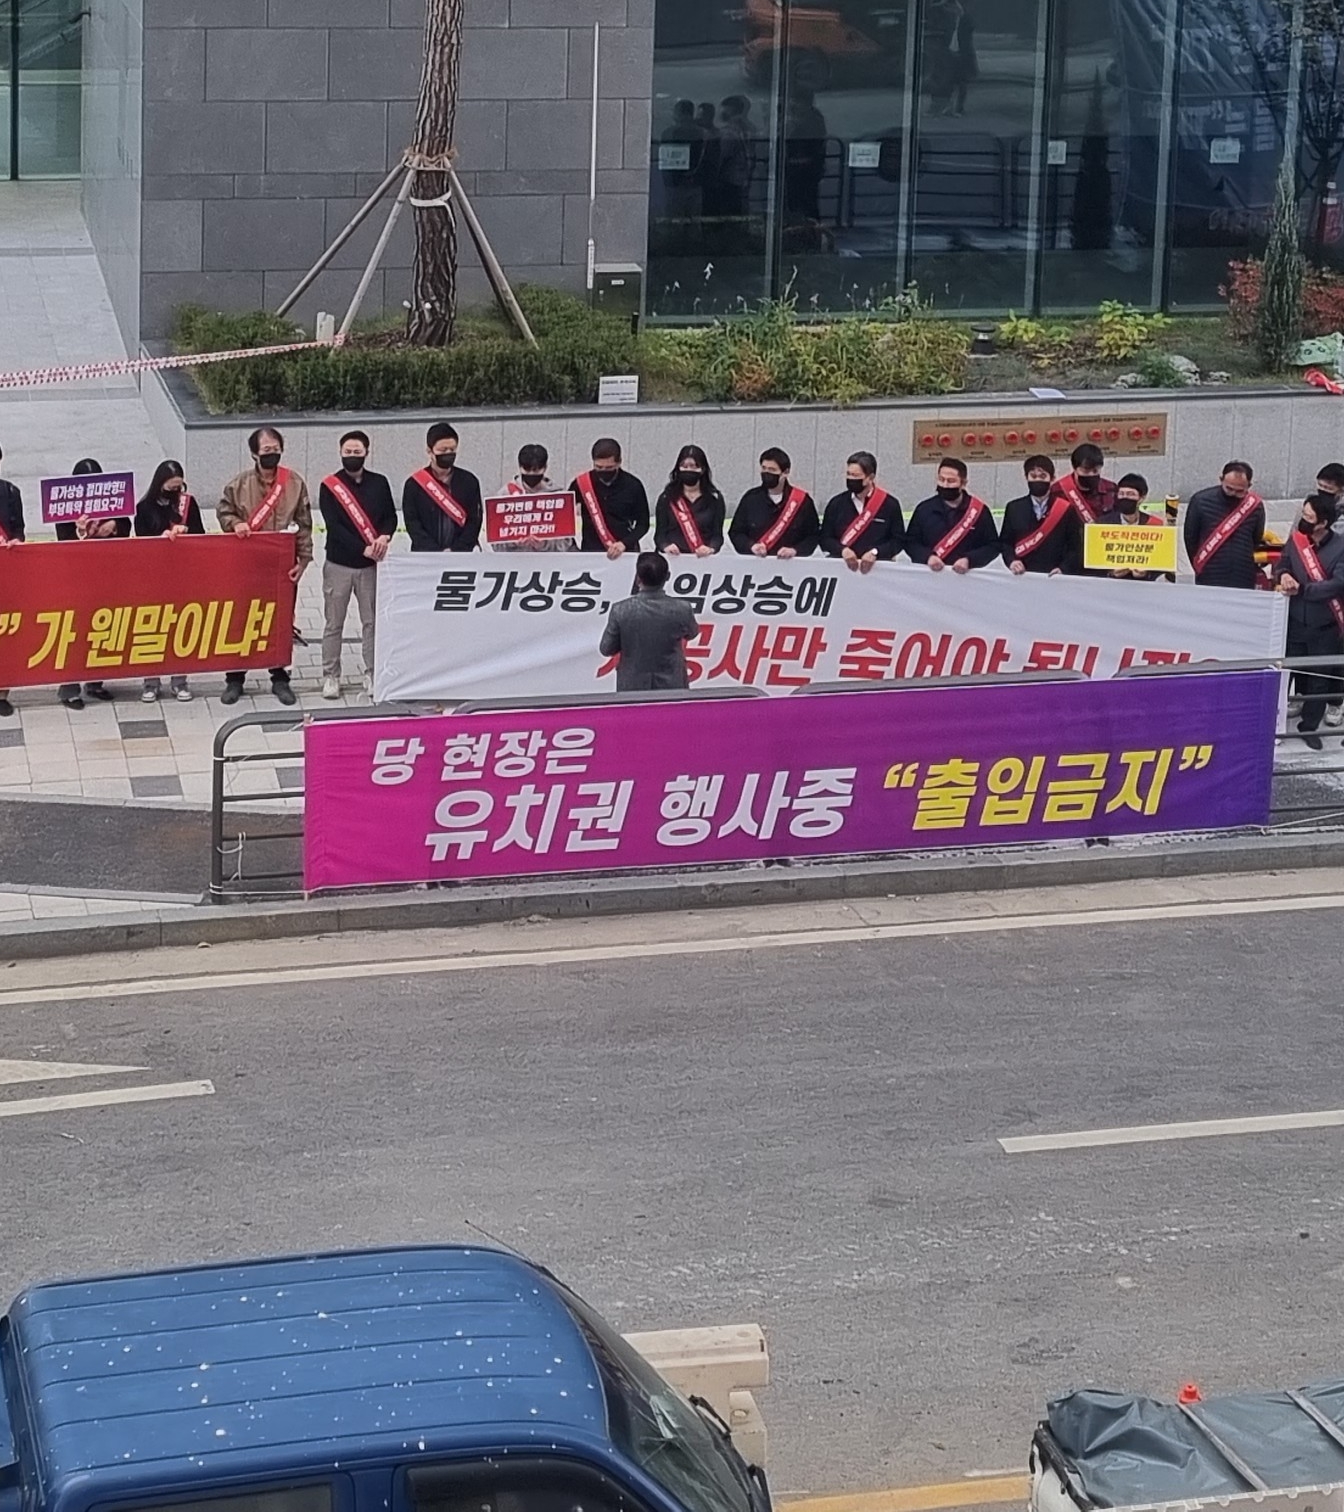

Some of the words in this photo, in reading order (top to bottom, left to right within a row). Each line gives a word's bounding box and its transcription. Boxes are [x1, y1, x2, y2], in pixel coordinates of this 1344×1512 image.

[504, 512, 542, 525] 우리에게
[543, 512, 554, 522] 다
[1100, 530, 1163, 541] 부도직전이다!
[434, 570, 610, 615] 물가상승,
[631, 571, 837, 617] 임상승에
[27, 609, 77, 670] 가
[86, 598, 276, 668] 웬말이냐!
[596, 624, 827, 687] 공사만
[371, 737, 426, 786] 당
[440, 727, 597, 782] 현장은
[424, 778, 635, 862] 유치권
[655, 767, 857, 847] 행사중
[883, 744, 1214, 831] “출입금지”
